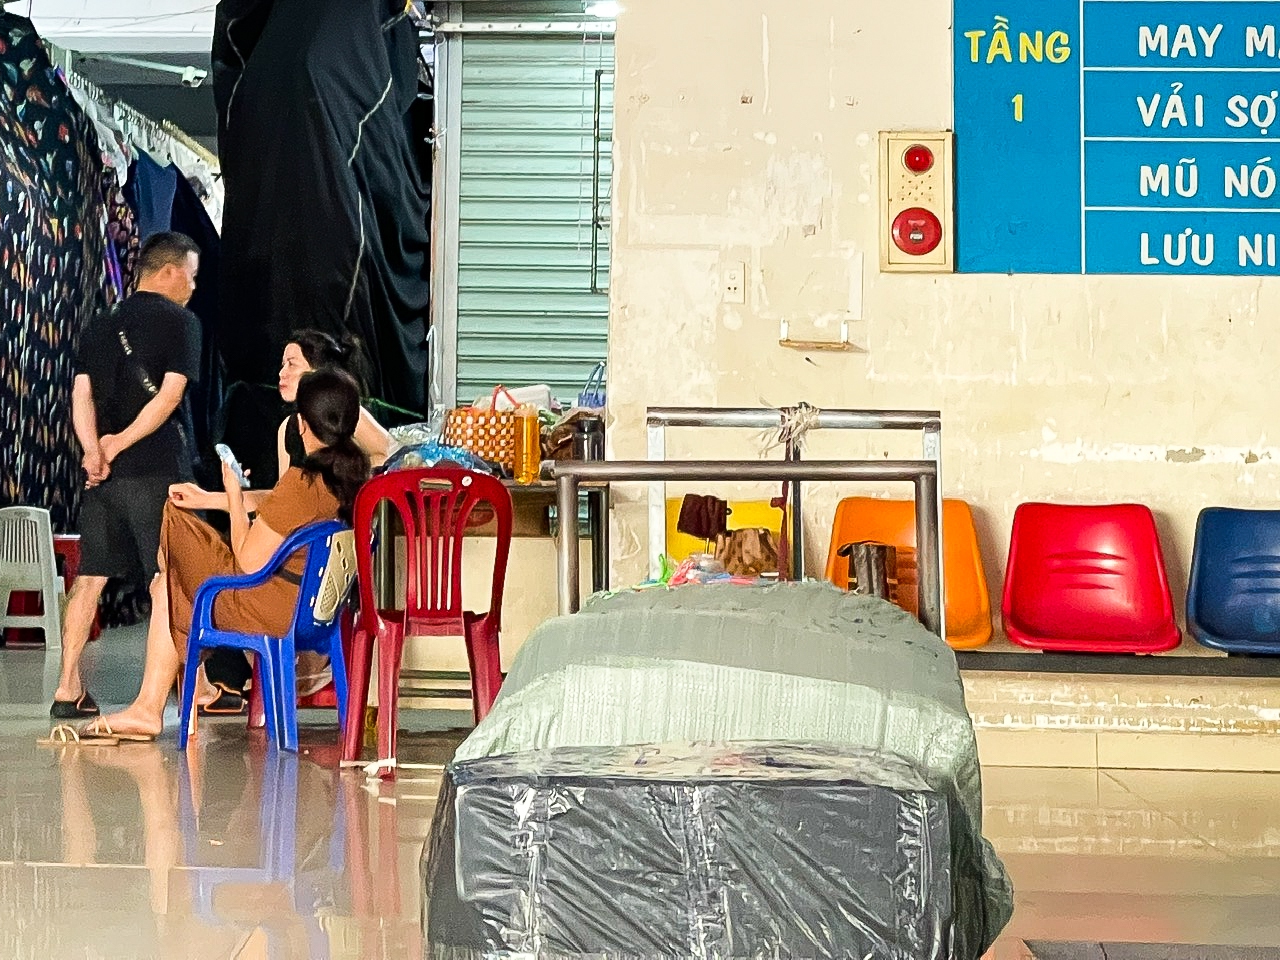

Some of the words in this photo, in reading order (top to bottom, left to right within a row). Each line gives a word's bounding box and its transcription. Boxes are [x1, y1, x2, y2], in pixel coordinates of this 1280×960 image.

[964, 15, 1071, 65] TẦNG
[1138, 23, 1224, 58] MAY
[1245, 24, 1280, 58] M
[1010, 93, 1025, 122] 1
[1136, 82, 1205, 129] VẢI
[1224, 90, 1278, 135] SỢ
[1139, 158, 1198, 198] MŨ
[1224, 156, 1276, 198] NÓ
[1140, 225, 1215, 266] LƯU
[1238, 233, 1276, 267] NI
